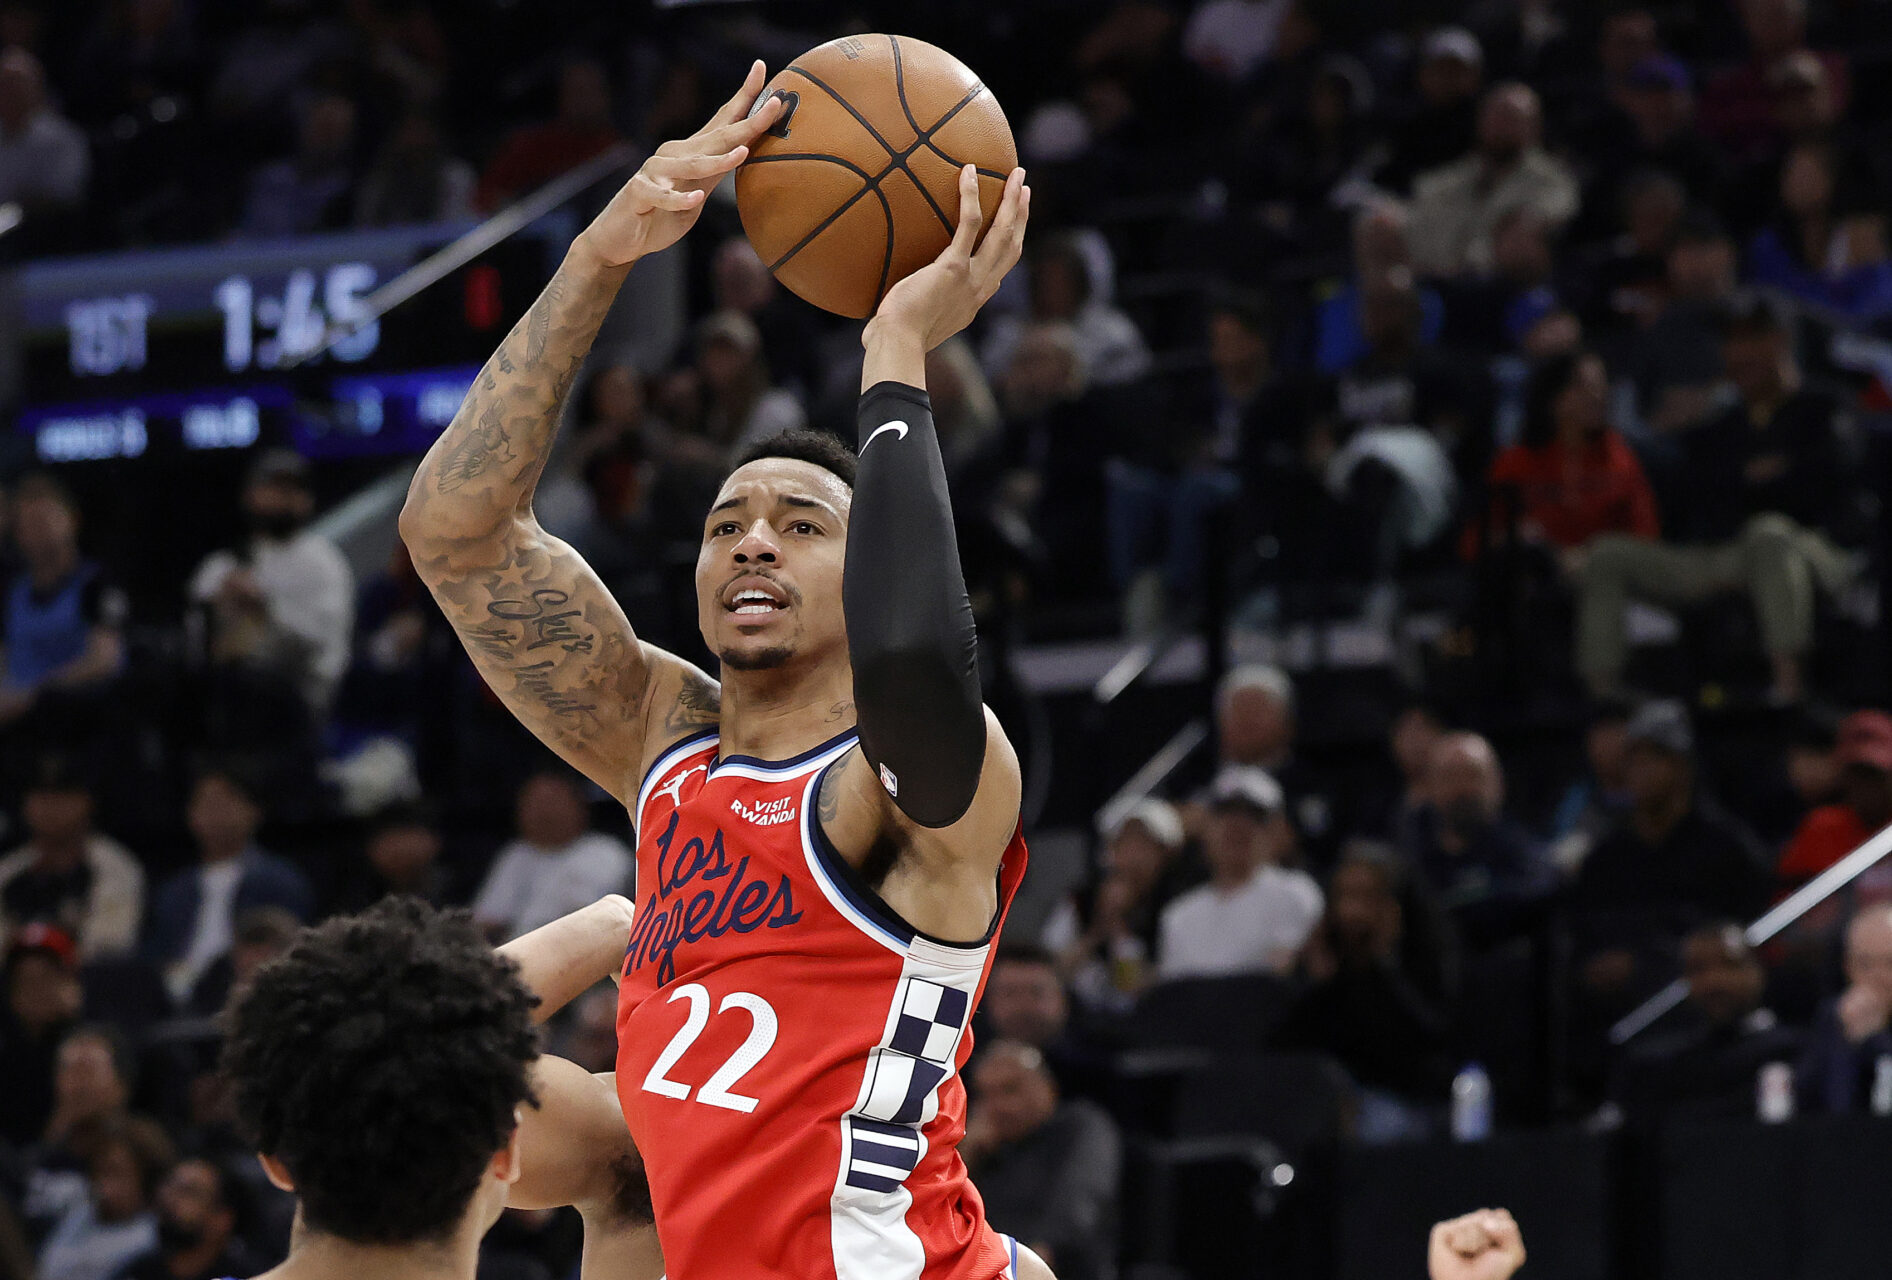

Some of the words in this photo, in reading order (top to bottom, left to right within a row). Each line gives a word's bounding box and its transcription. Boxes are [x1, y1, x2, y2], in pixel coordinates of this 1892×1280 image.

[215, 262, 381, 373] 1:45
[656, 810, 734, 901] Los
[730, 799, 796, 826] RWANDA
[755, 796, 792, 814] VISIT
[625, 855, 804, 988] Angeles
[642, 983, 778, 1113] 22
